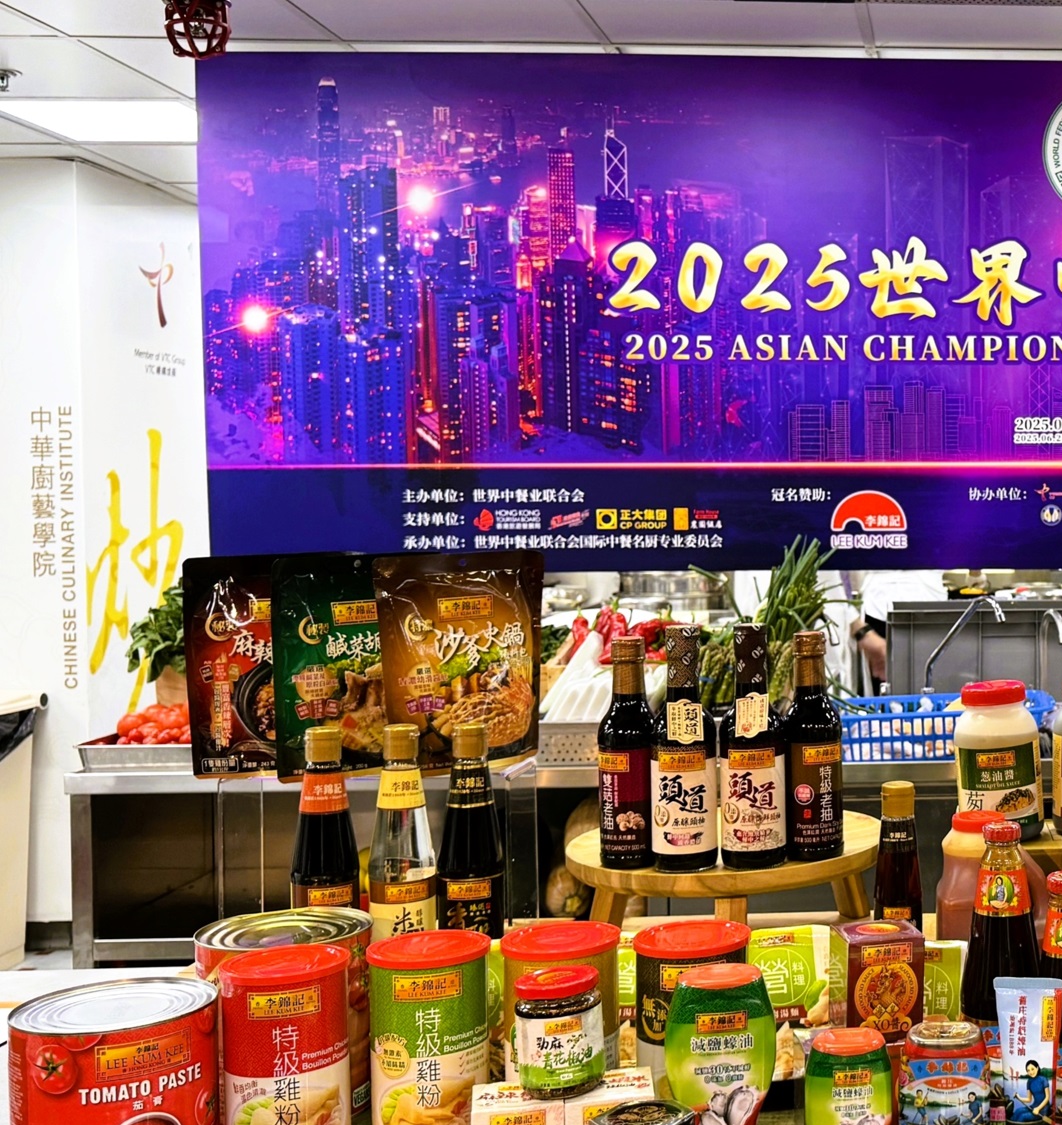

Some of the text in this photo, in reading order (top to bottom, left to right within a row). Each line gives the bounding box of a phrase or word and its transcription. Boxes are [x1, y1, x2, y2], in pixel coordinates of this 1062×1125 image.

[625, 334, 714, 362] 2025
[728, 334, 849, 361] ASIAN
[29, 406, 58, 578] 中華廚藝學院
[472, 488, 585, 503] 世界中餐业联合会
[620, 521, 667, 530] CP GROUP
[864, 513, 902, 528] 李錦記
[58, 405, 79, 689] CHINESE CULINARY INSTITUTE
[473, 535, 723, 550] 世界中餐业联合会国际中餐名厨专业委员会
[830, 534, 908, 549] LEE KUM KEE
[452, 600, 481, 611] 李錦記
[312, 783, 343, 795] 李錦記
[391, 780, 419, 791] 李錦記
[456, 777, 485, 788] 李錦記
[659, 774, 708, 813] 頭道
[728, 771, 778, 810] 頭道
[819, 765, 833, 822] 特級老抽
[320, 888, 346, 899] 李錦記
[456, 884, 482, 894] 李錦記
[874, 947, 901, 958] 李錦記
[792, 961, 805, 987] 料理
[408, 988, 447, 998] LEE KUM KEE
[409, 978, 447, 993] 李錦記
[265, 993, 305, 1009] 李錦記
[935, 981, 948, 1010] 料理
[263, 1005, 292, 1016] LEE KUM
[708, 1015, 736, 1025] 李錦記
[443, 1030, 474, 1043] Premium
[691, 1033, 754, 1053] 減鹽蠔油
[135, 1042, 160, 1055] 李錦記
[301, 1046, 332, 1061] Premium
[443, 1039, 472, 1053] Bouillon
[106, 1043, 184, 1070] LEE KUM KEE
[301, 1055, 331, 1071] Bouillon
[415, 1008, 441, 1108] 特級雞粉
[542, 1043, 593, 1070] 青花椒油
[128, 1059, 166, 1073] HONG KONG
[78, 1062, 202, 1106] TOMATO PASTE
[132, 1095, 164, 1111] 茄膏
[504, 1114, 533, 1125] 李錦記
